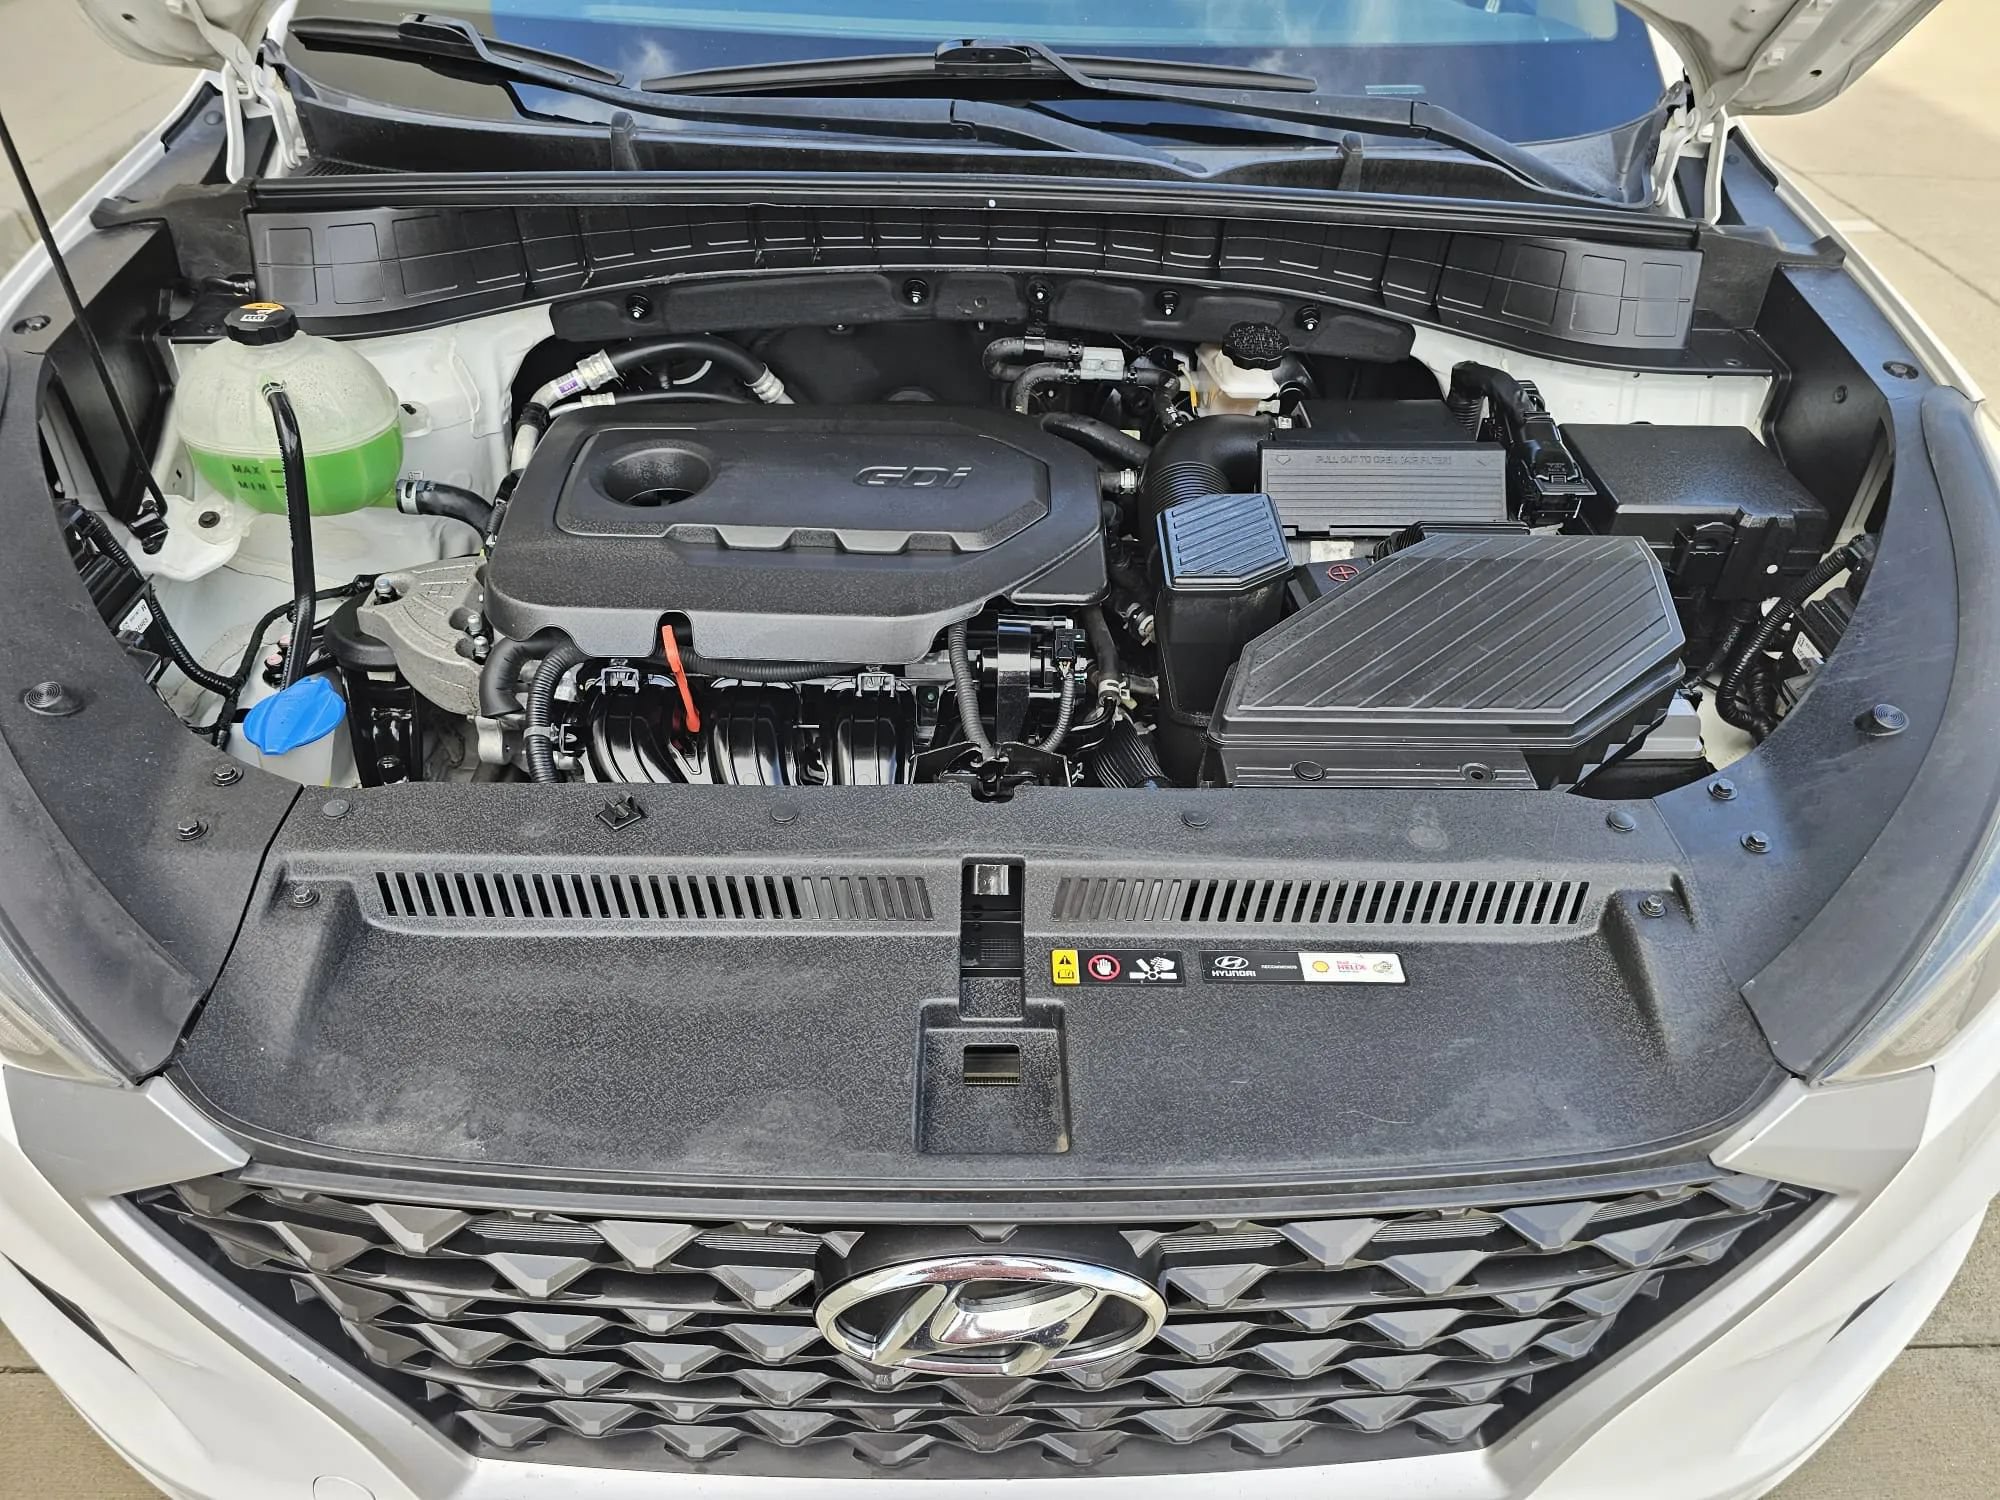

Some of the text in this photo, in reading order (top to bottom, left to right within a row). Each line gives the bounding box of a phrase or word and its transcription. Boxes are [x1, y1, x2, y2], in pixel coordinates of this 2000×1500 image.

[1340, 455, 1359, 464] OUT
[1360, 455, 1372, 464] TO
[232, 464, 259, 474] MAX
[854, 466, 972, 488] GDi
[238, 481, 266, 490] MIN
